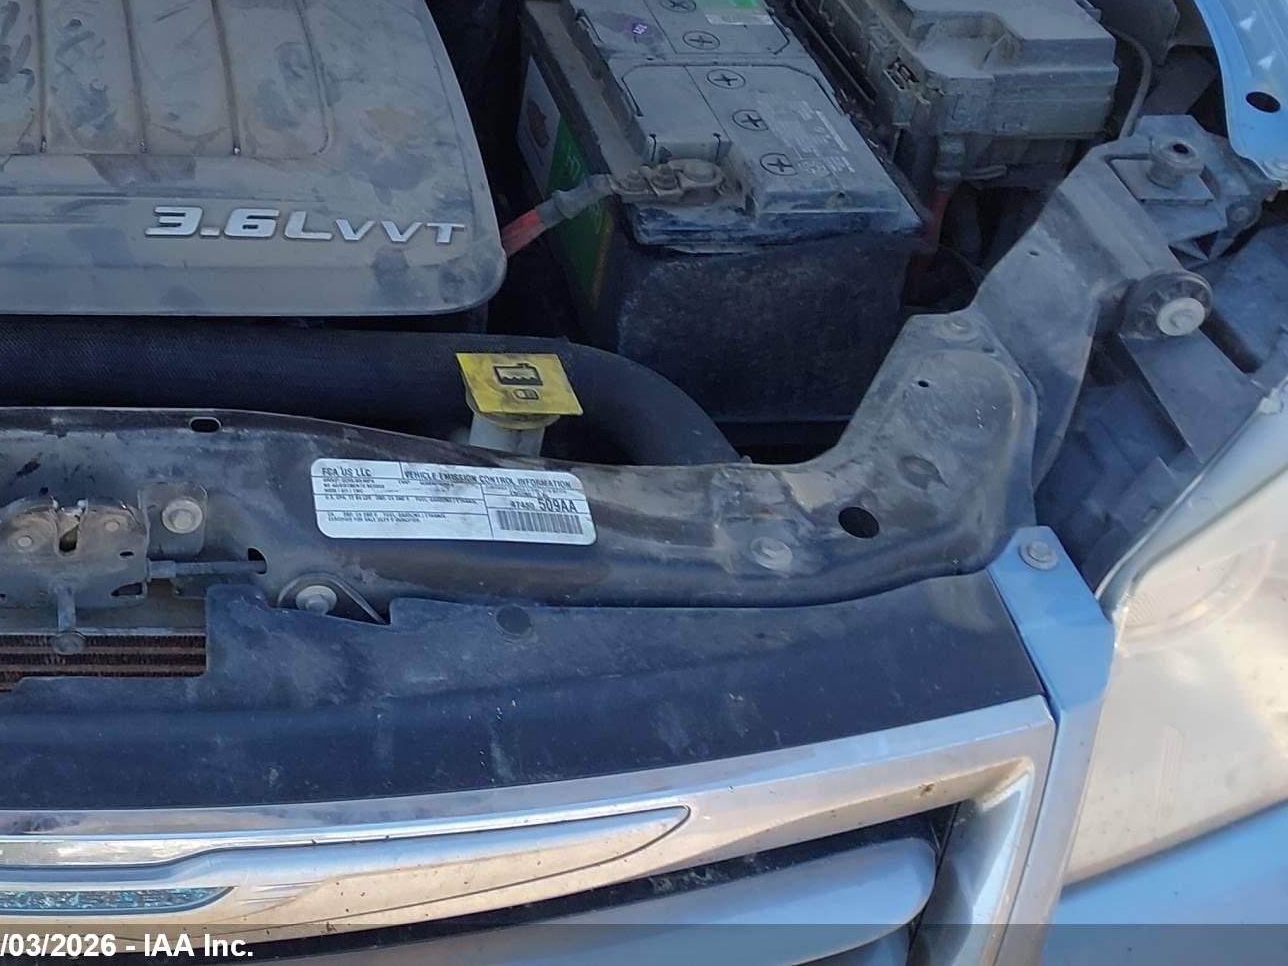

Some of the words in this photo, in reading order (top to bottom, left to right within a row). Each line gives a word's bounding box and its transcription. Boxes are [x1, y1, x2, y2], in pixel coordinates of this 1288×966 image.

[321, 467, 339, 476] FCA
[340, 466, 353, 476] US
[354, 467, 372, 477] LLC
[404, 470, 437, 480] VEHICLE
[437, 472, 478, 483] EMISSION
[479, 475, 514, 485] CONTROL
[516, 478, 572, 489] INFORMATION
[538, 499, 577, 512] 509AA
